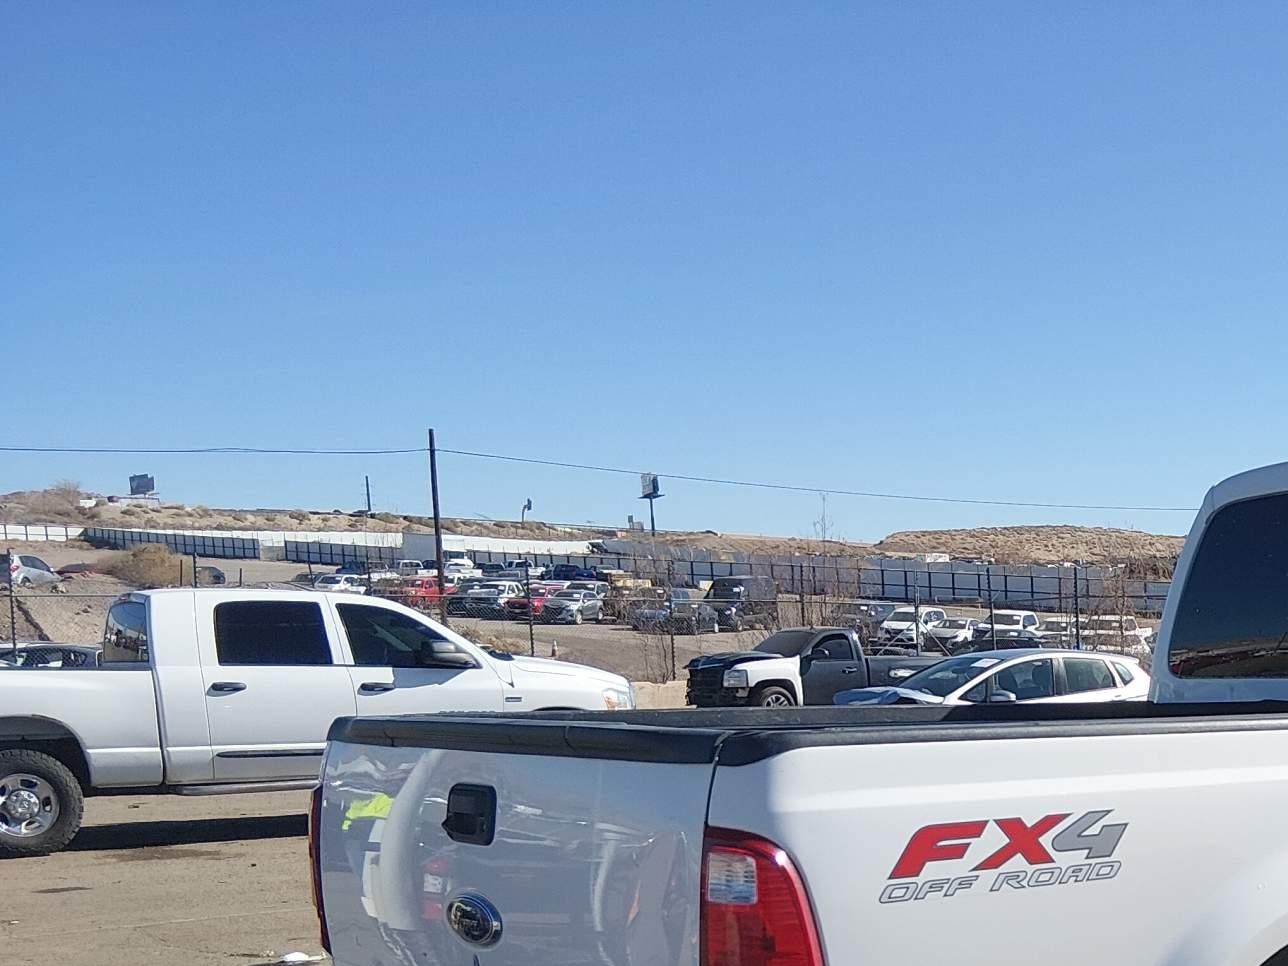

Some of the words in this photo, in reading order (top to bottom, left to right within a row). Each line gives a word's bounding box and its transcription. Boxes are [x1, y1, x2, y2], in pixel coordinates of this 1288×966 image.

[888, 809, 1129, 880] FX4
[878, 875, 980, 904] OFF
[989, 861, 1122, 892] ROAD
